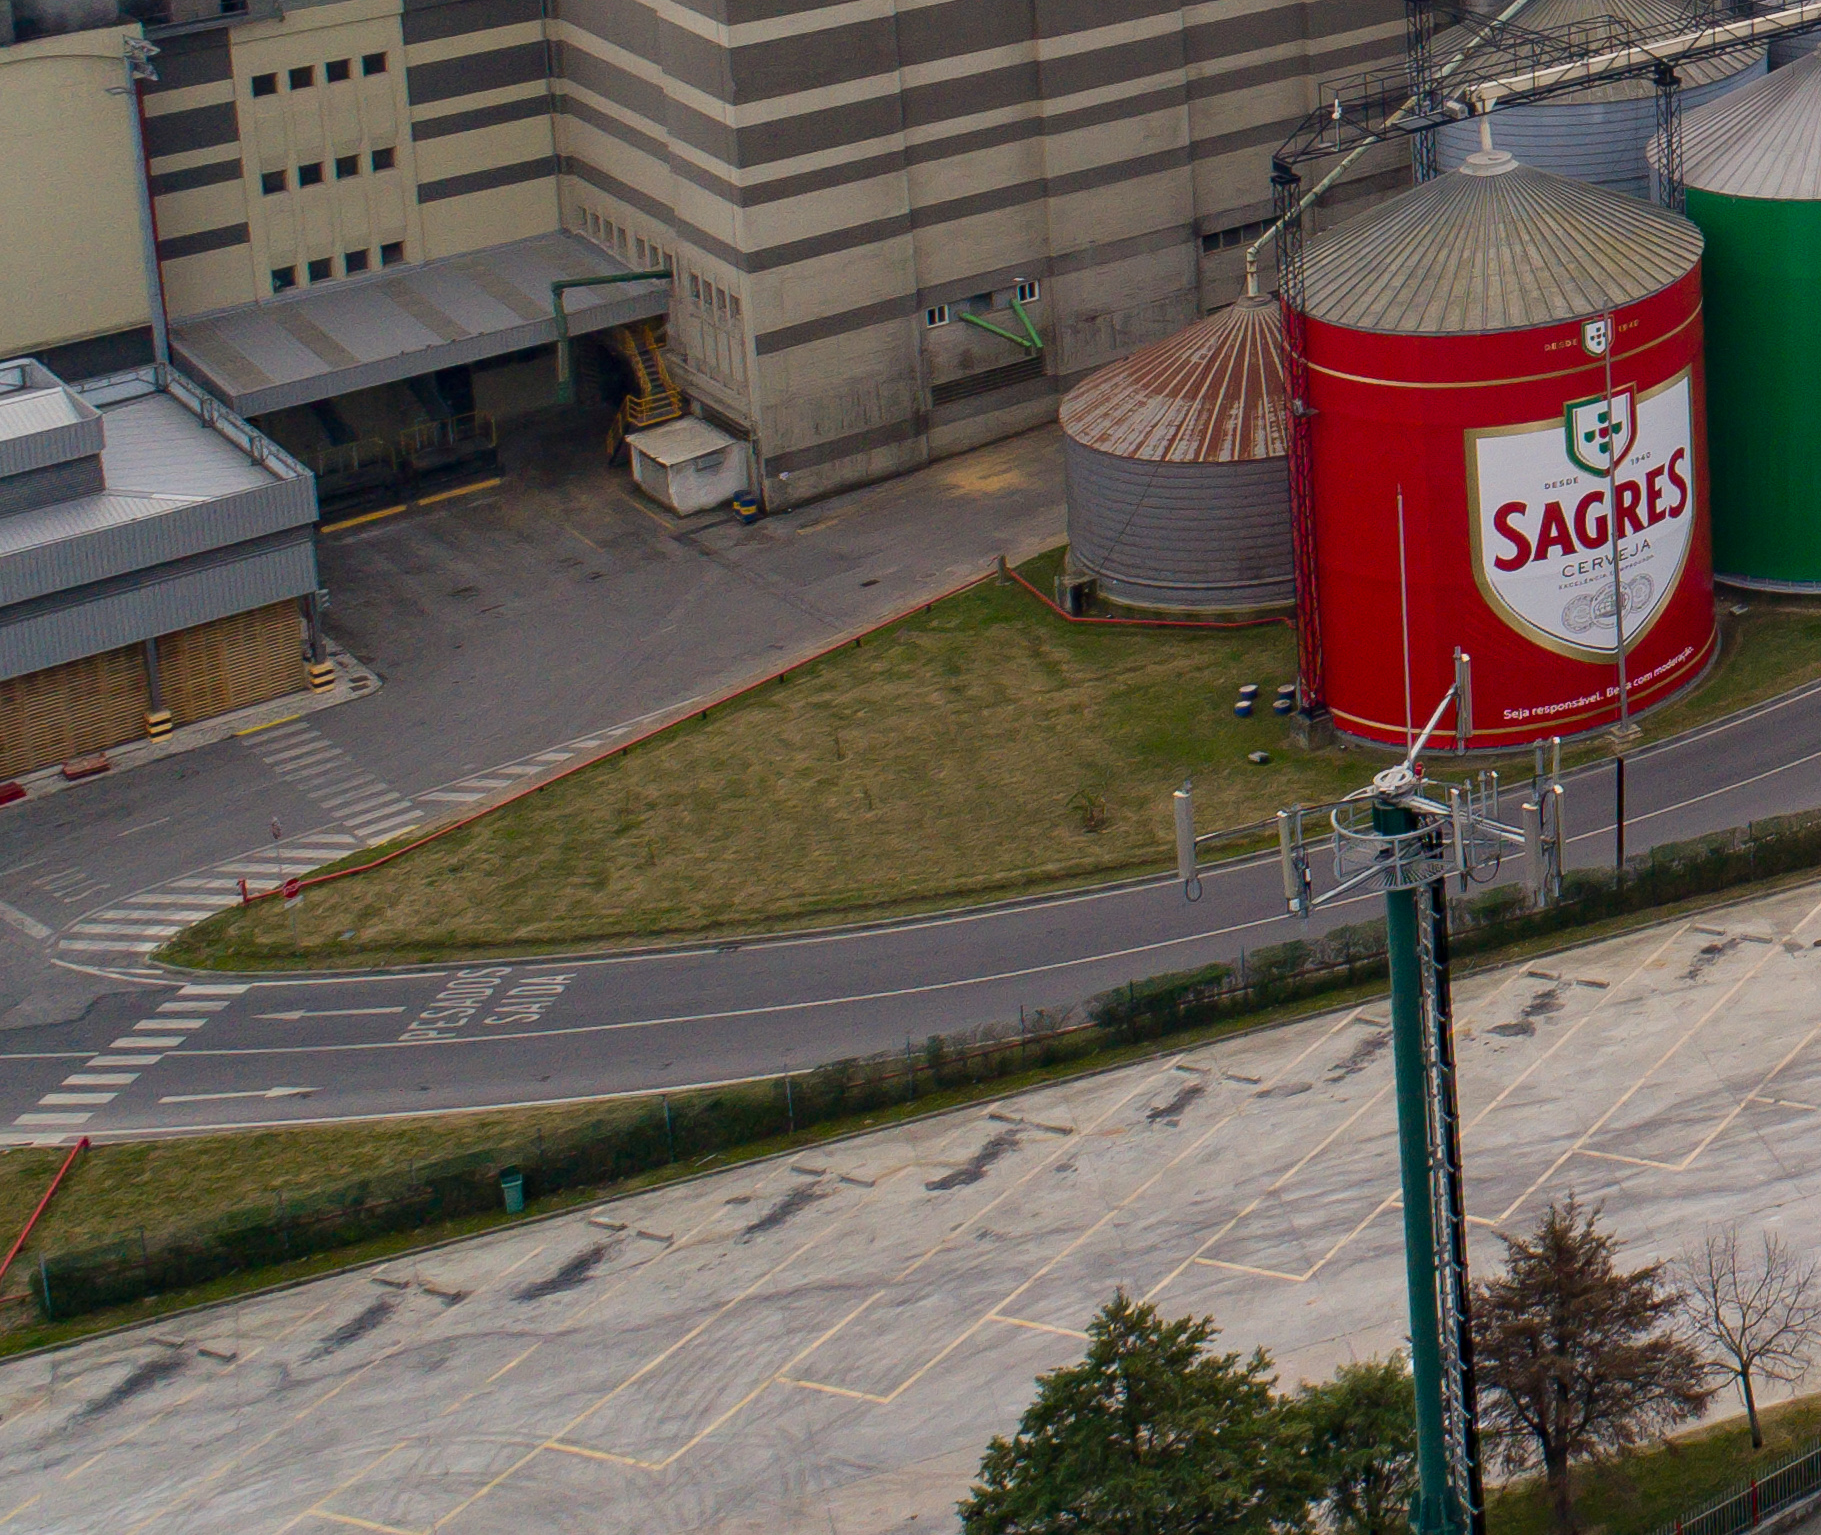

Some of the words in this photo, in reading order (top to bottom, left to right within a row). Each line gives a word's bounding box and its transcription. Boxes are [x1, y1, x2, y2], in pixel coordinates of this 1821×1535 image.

[1543, 475, 1579, 490] DESDE
[1492, 446, 1688, 573] SAGRES
[1561, 538, 1651, 579] CERVEJA
[1503, 707, 1530, 721] Seja
[1531, 691, 1605, 716] responsável.
[1606, 682, 1632, 698] Bea
[398, 966, 513, 1041] PESADOS
[484, 972, 577, 1025] SAIDA
